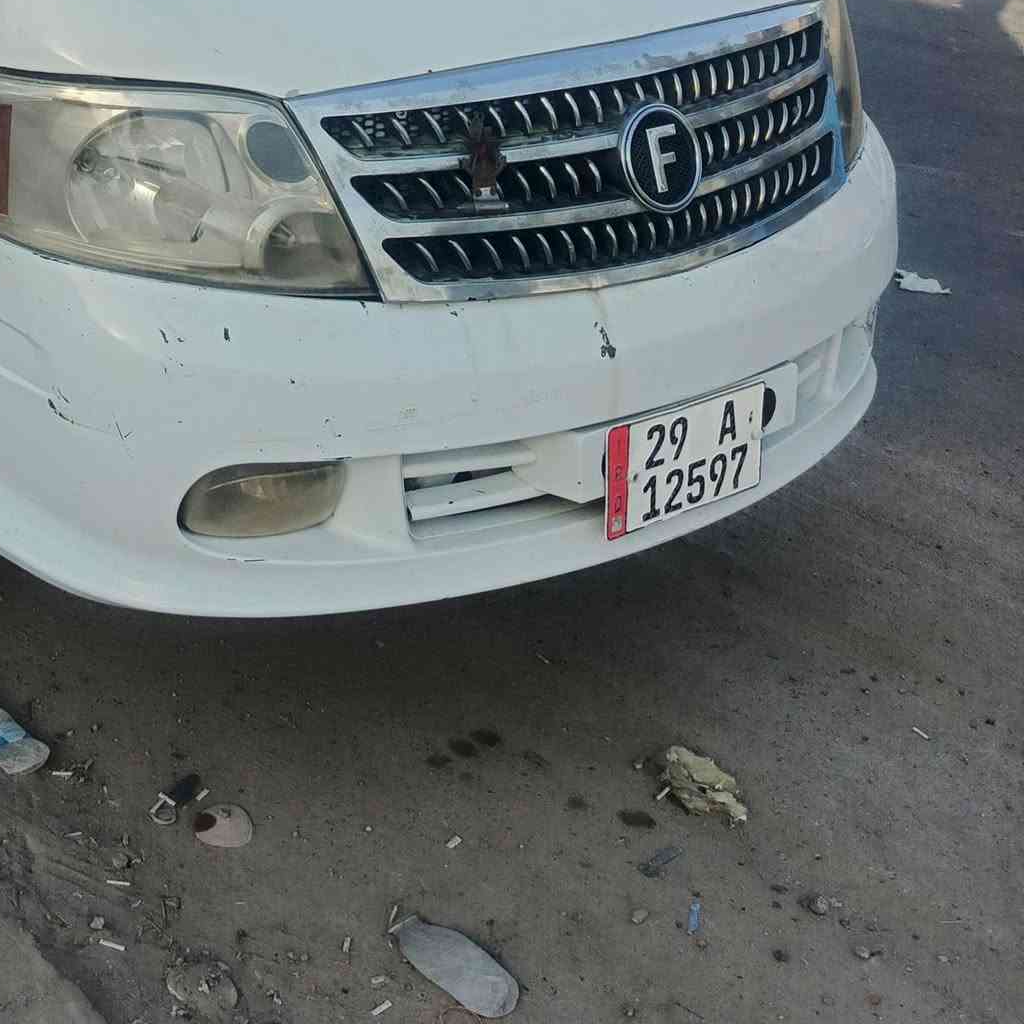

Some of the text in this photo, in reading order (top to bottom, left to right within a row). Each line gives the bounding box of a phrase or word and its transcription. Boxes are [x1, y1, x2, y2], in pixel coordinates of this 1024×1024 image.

[646, 123, 676, 193] F
[645, 399, 737, 470] 29 A
[642, 443, 748, 522] 12597
